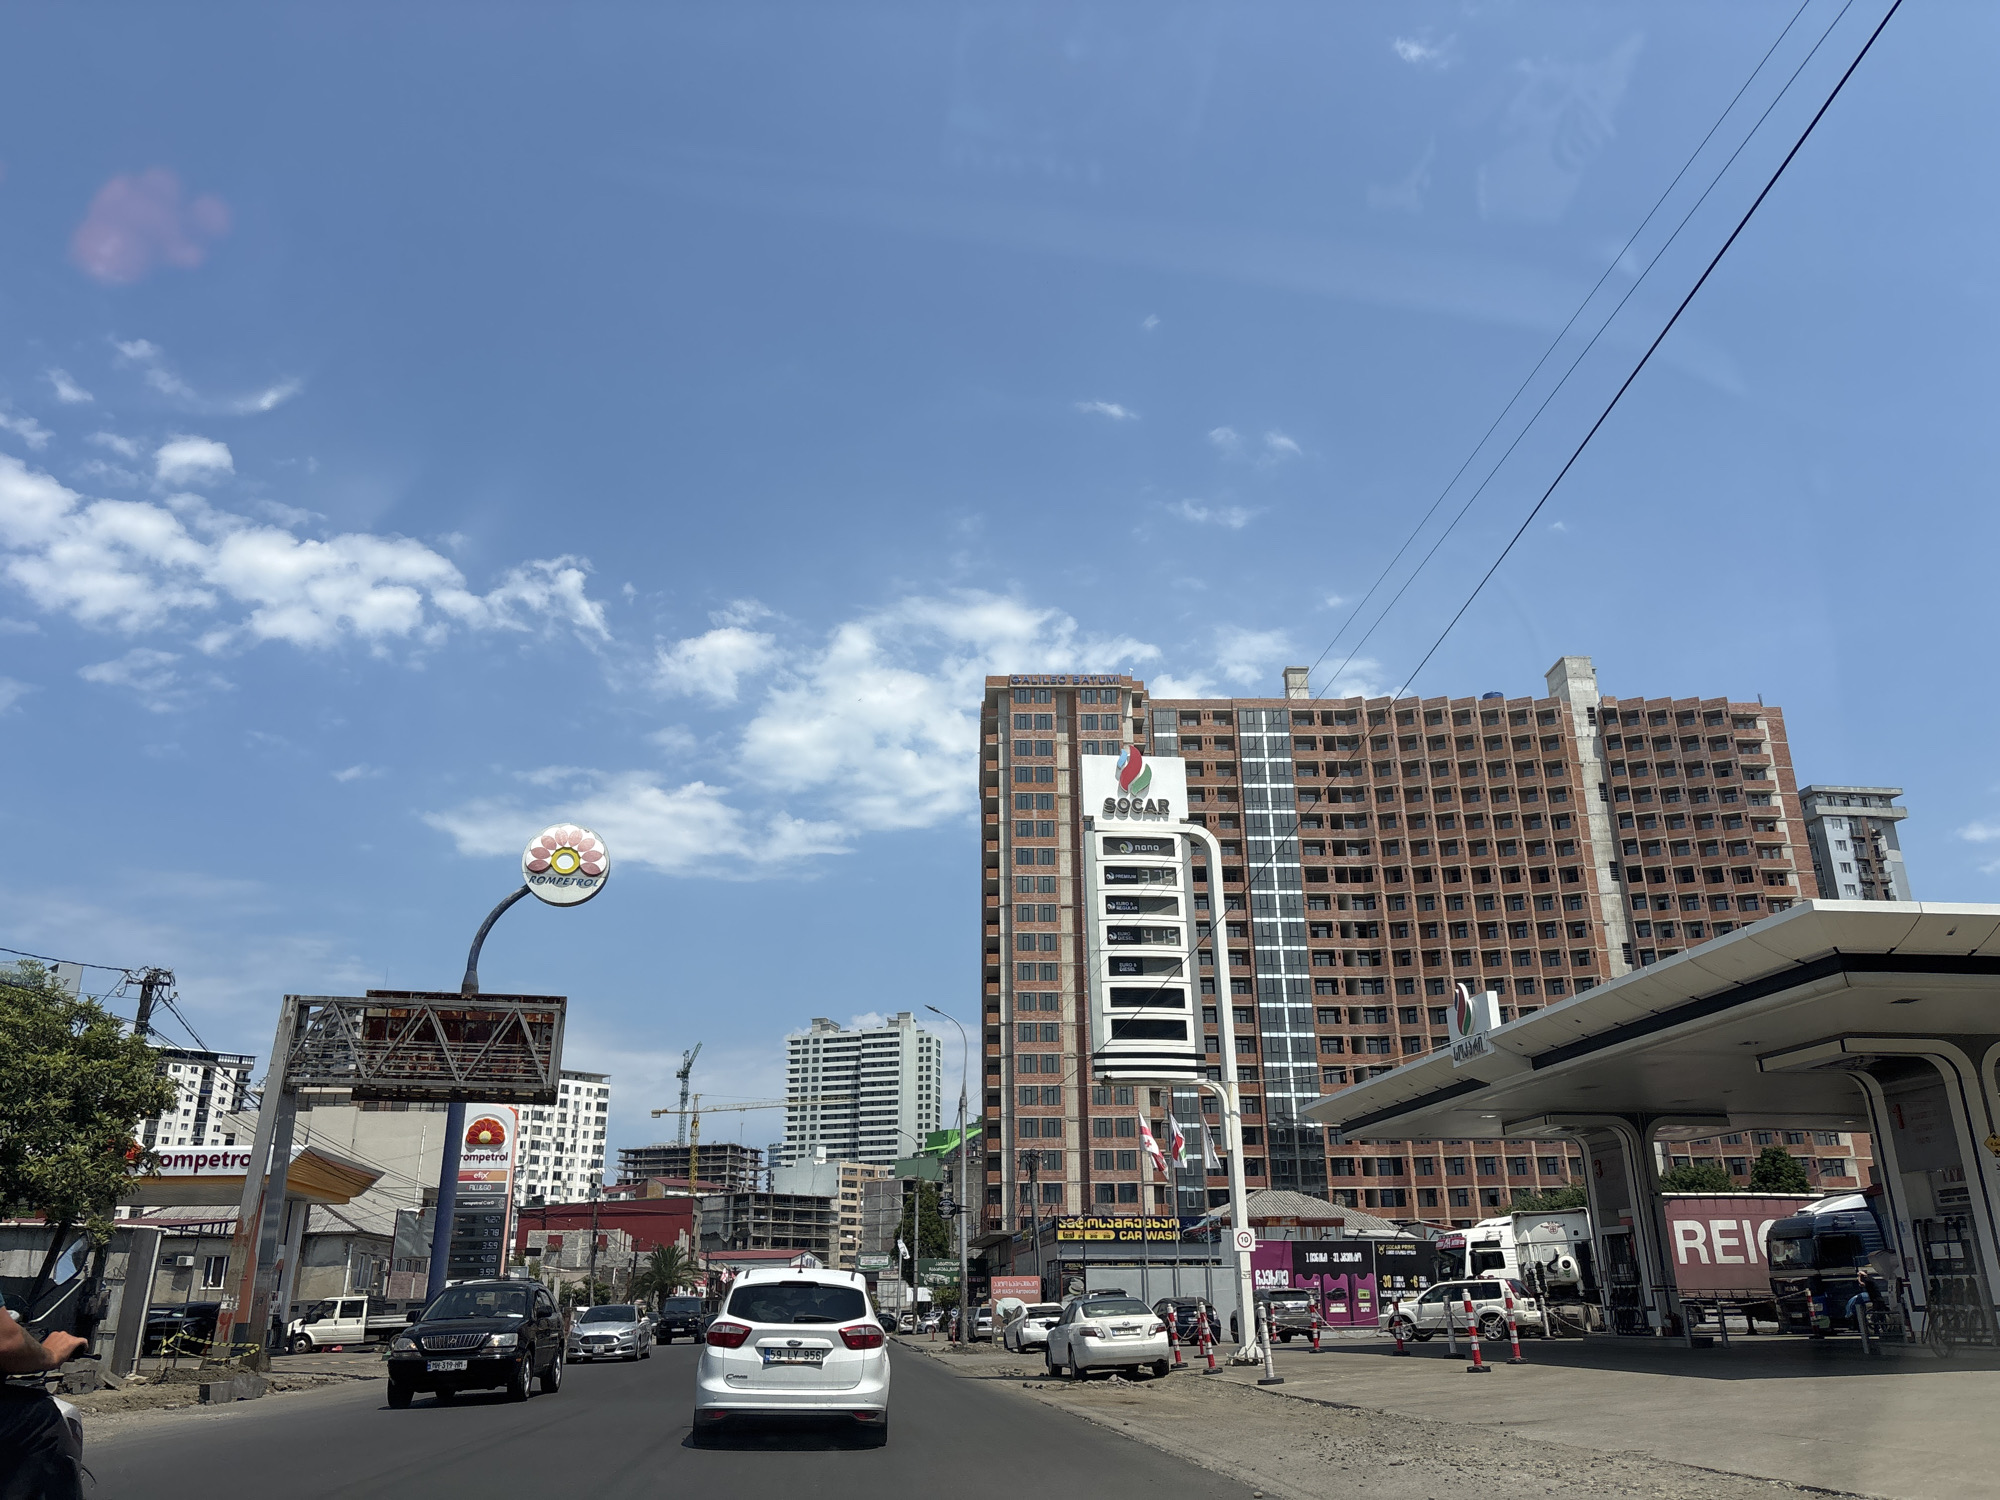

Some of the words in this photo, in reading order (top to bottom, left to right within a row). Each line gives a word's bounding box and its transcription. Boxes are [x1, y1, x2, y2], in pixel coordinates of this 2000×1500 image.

[1011, 674, 1067, 685] GALILEO
[1072, 675, 1120, 685] BATUMI
[1103, 797, 1170, 815] SOCAR
[529, 875, 600, 887] ROMPETROL
[1140, 869, 1175, 885] 3.75
[1143, 929, 1178, 945] 4.15
[160, 1151, 252, 1173] ompetro
[1119, 1230, 1143, 1241] CAR
[1145, 1230, 1181, 1241] WASH
[770, 1350, 782, 1360] 59
[787, 1350, 799, 1360] LY
[803, 1350, 822, 1360] 956
